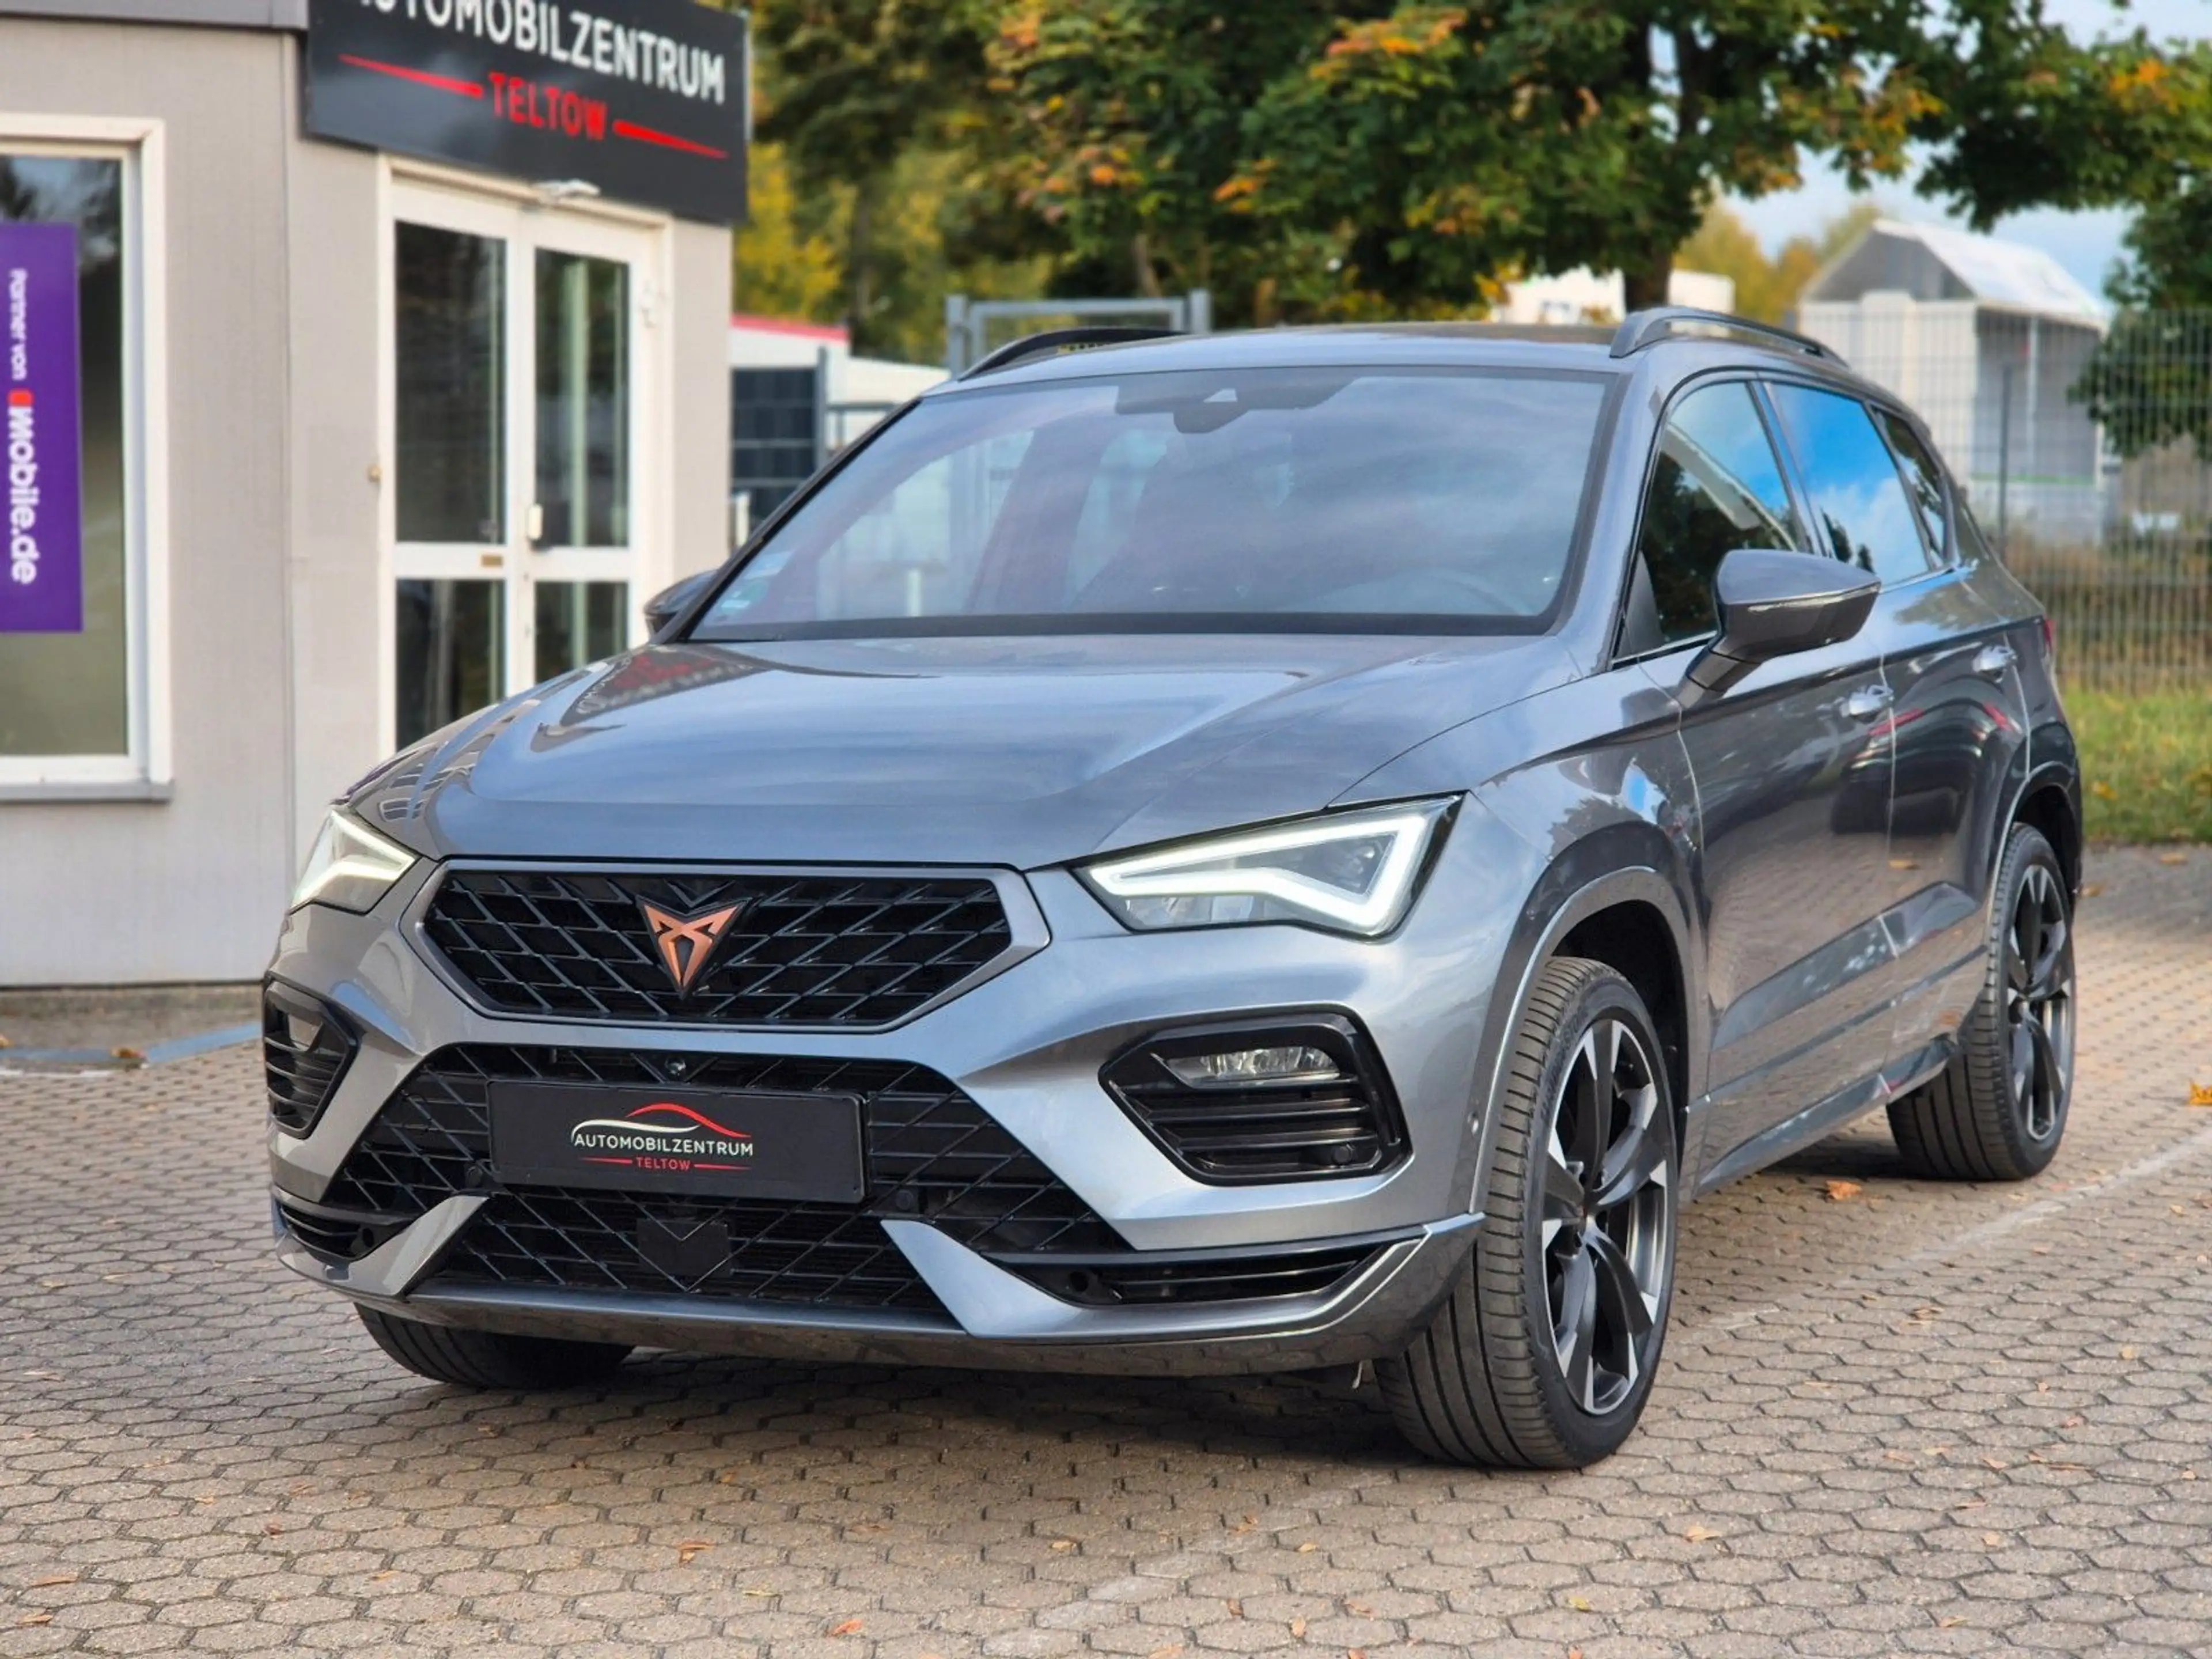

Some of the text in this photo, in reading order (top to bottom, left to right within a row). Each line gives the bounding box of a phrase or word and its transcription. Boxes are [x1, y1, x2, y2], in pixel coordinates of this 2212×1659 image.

[488, 70, 608, 141] TELTOW
[10, 343, 28, 381] von
[7, 403, 40, 585] mobile.de
[574, 1133, 753, 1156] AUTOMOBILZENTRUM
[636, 1156, 692, 1171] TELTOW
